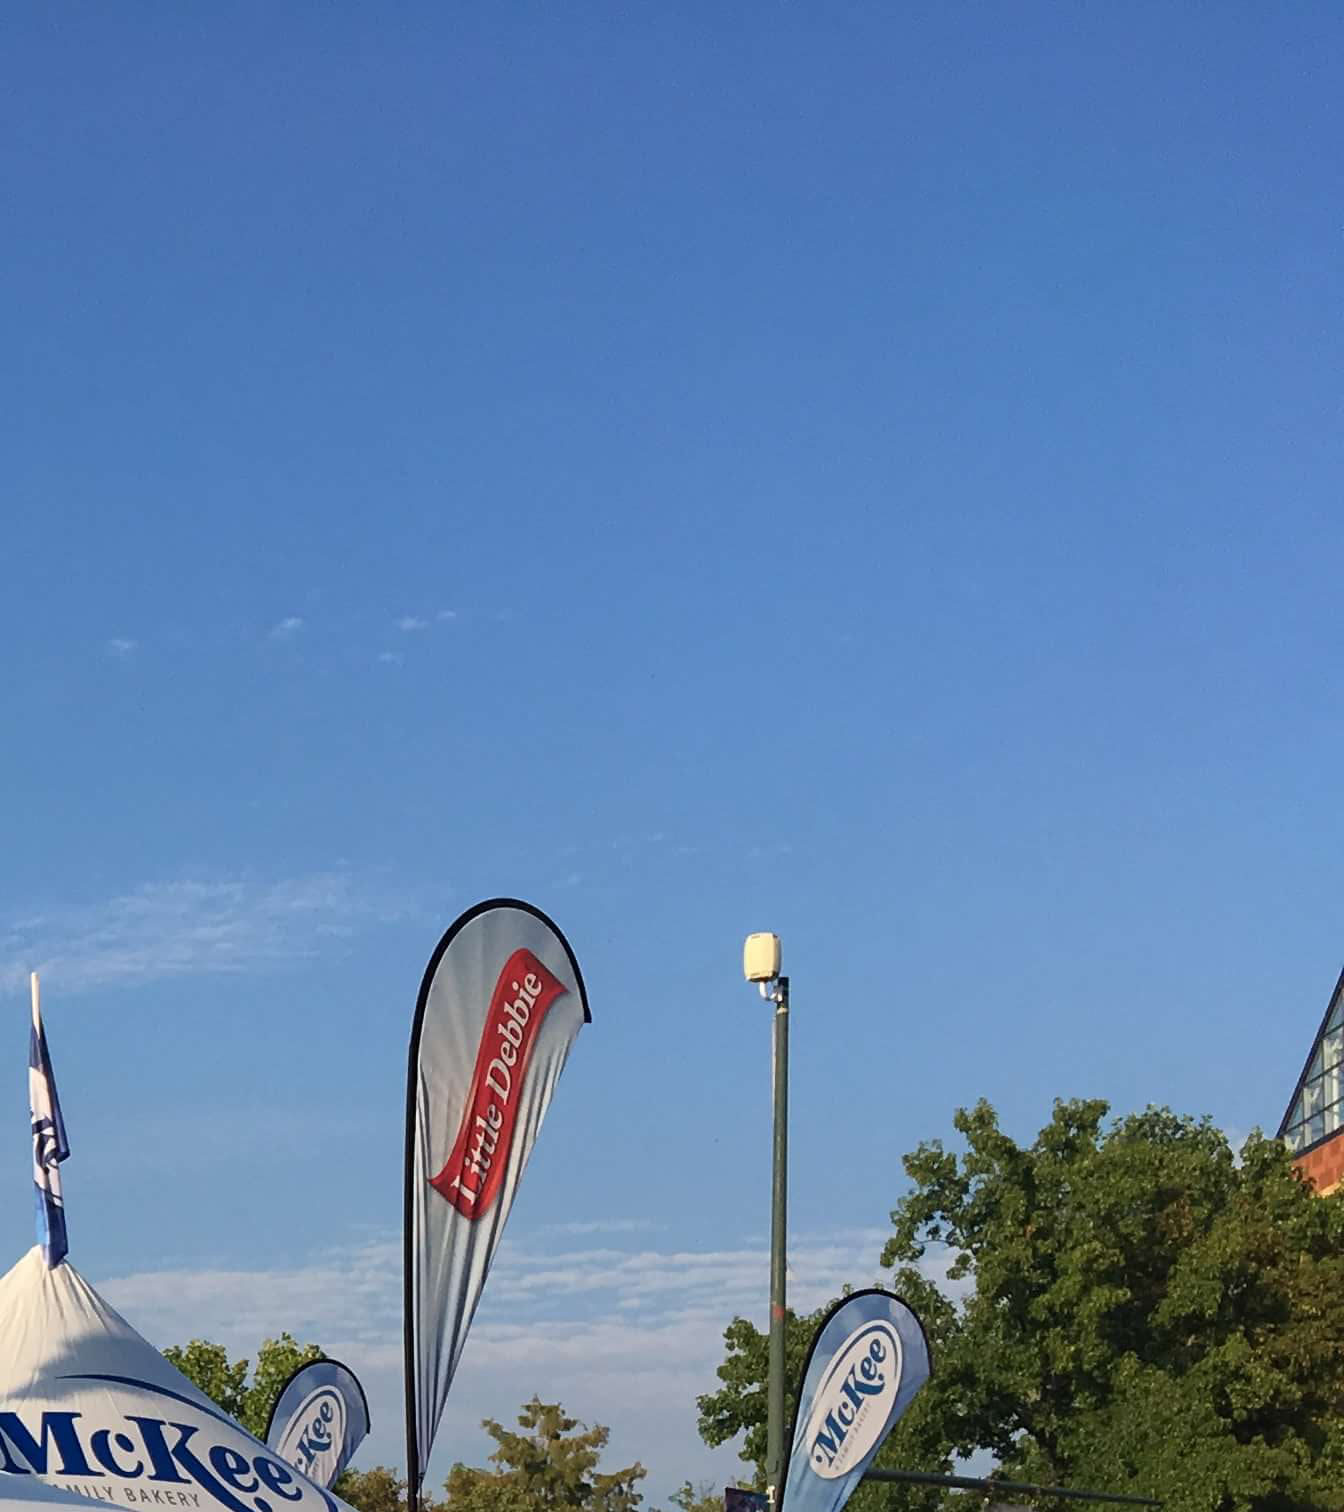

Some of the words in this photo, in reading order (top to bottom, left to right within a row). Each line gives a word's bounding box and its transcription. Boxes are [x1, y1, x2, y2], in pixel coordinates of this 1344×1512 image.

[451, 1103, 503, 1206] Little
[485, 971, 543, 1106] Debbie
[811, 1338, 887, 1468] McKee
[123, 1487, 201, 1508] BAKERY
